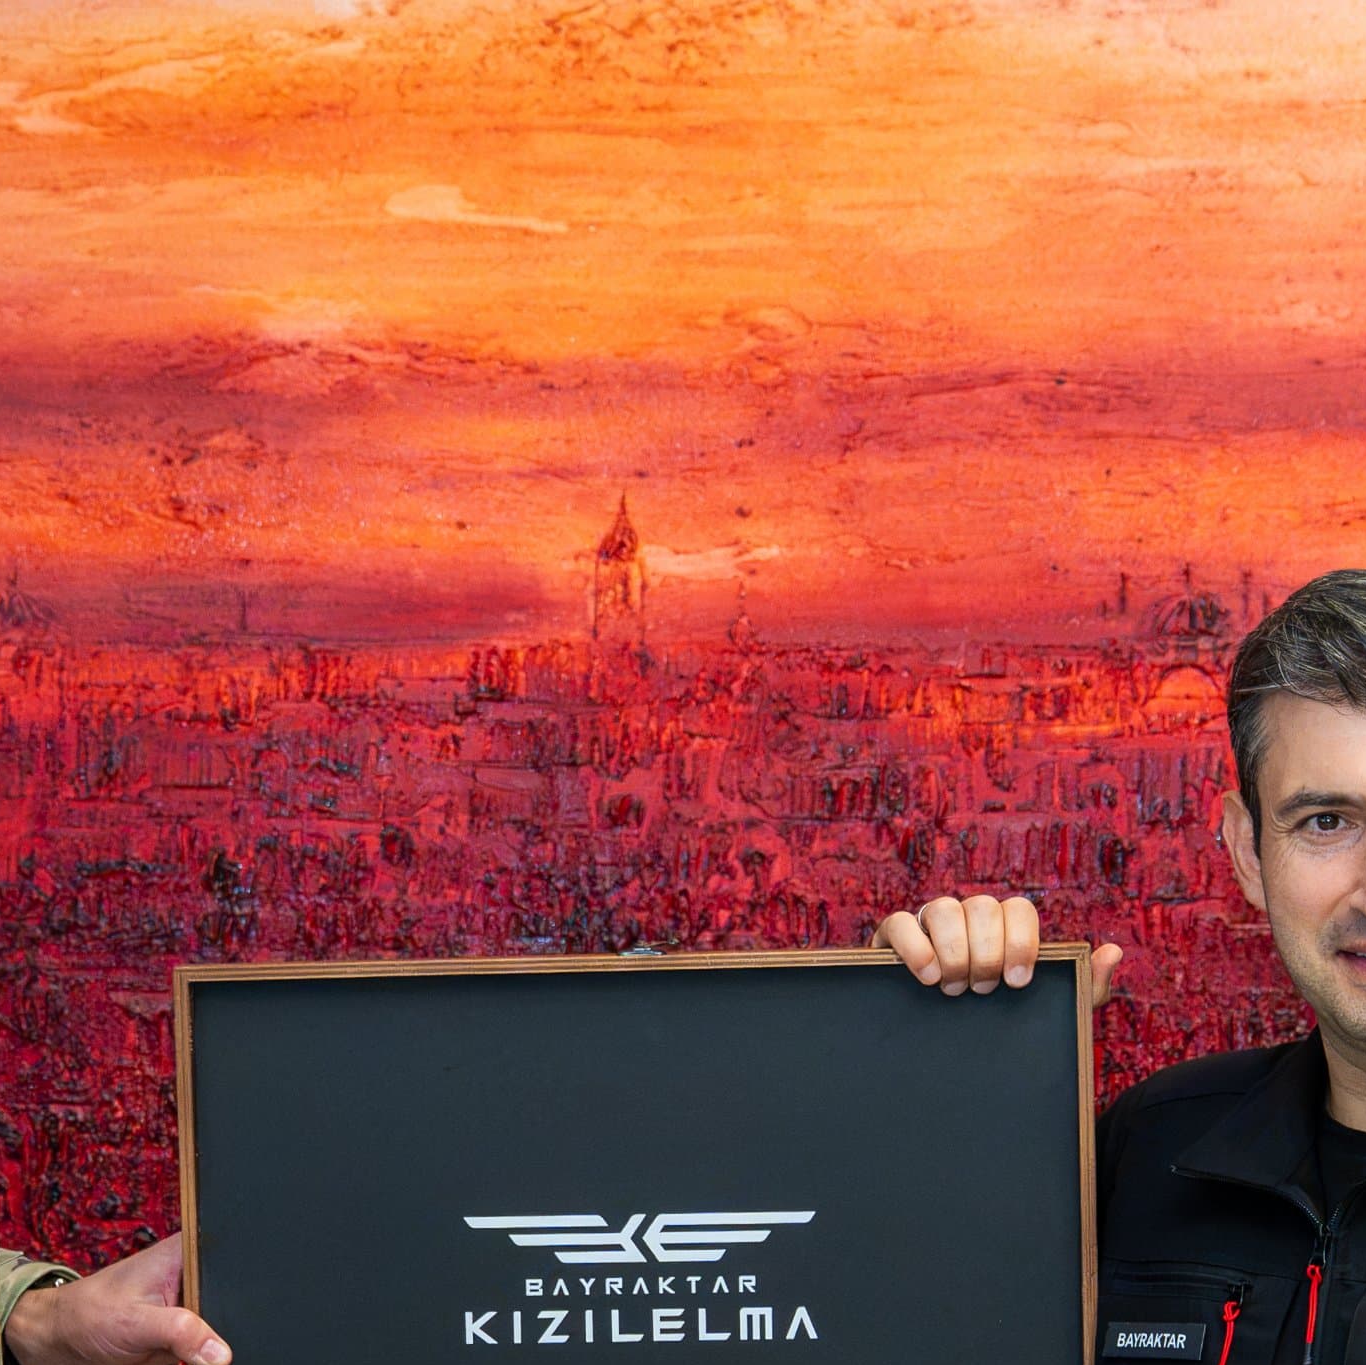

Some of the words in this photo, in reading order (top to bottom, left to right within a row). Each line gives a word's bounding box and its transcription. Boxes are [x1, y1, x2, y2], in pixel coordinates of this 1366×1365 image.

[525, 1275, 757, 1297] BAYRAKTAR
[464, 1306, 819, 1345] KIZILELMA
[1116, 1332, 1187, 1349] BAYRAKTAR
